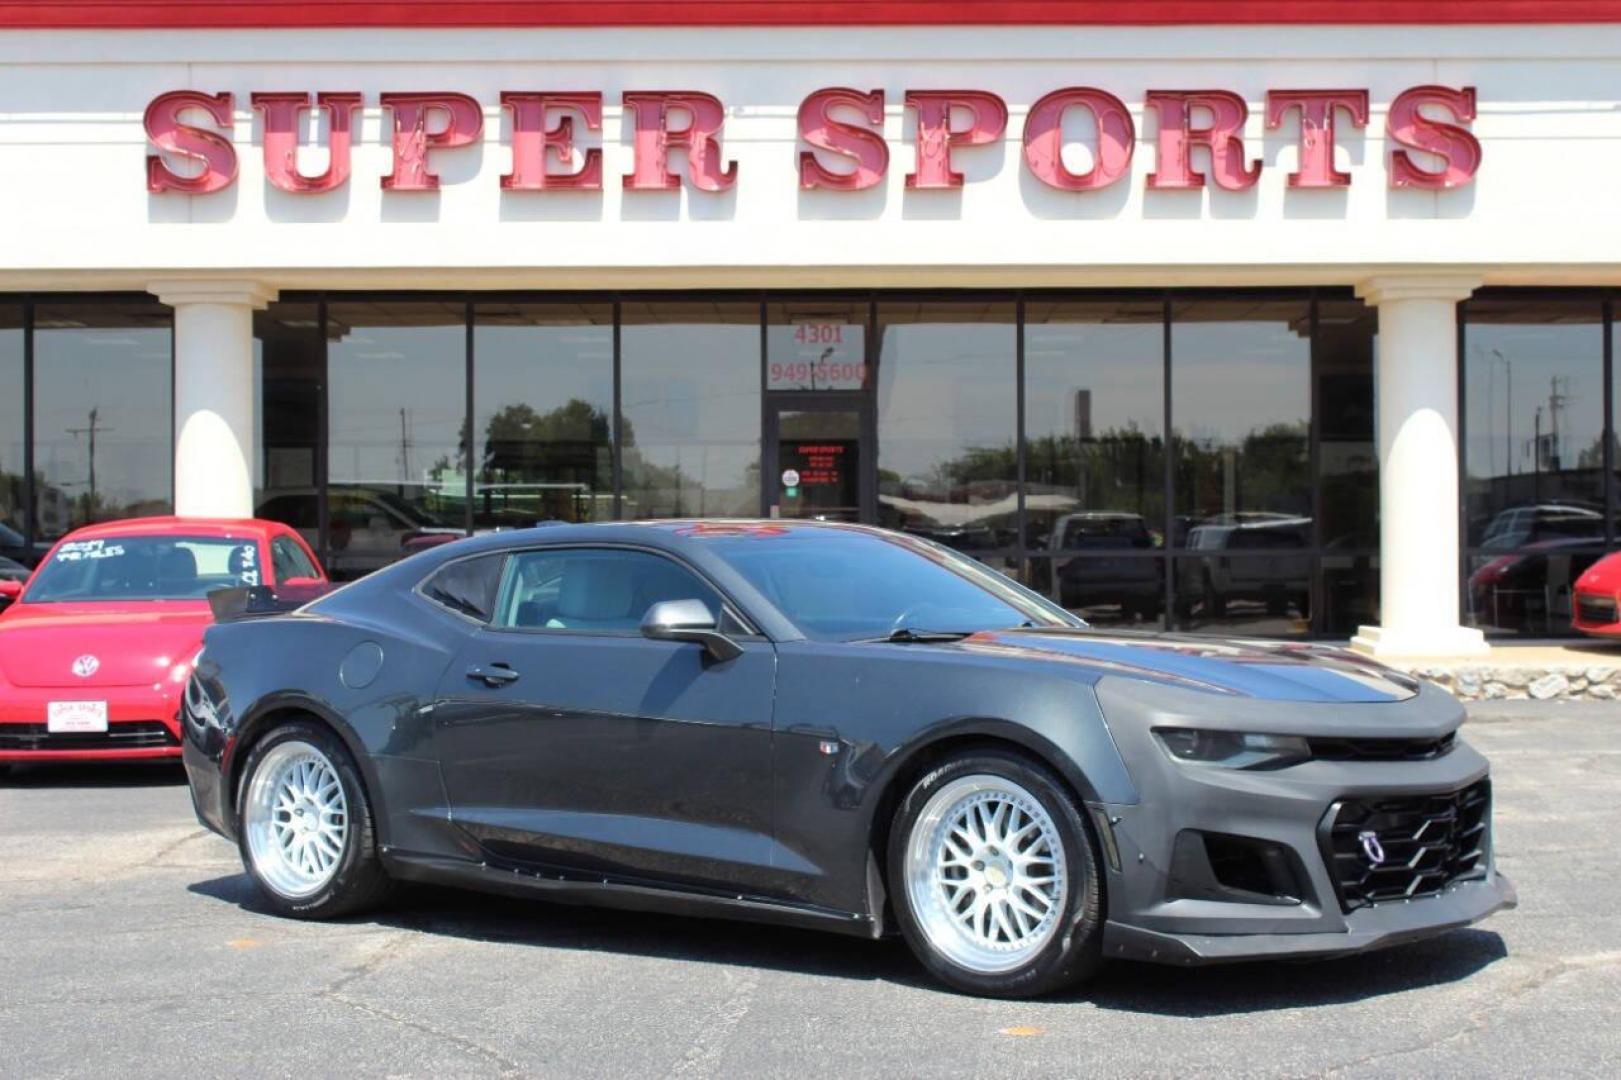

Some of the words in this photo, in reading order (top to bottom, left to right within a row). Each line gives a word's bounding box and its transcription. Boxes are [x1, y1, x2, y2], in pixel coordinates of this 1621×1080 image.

[144, 90, 738, 195] SUPER
[797, 86, 1482, 192] SPORTS
[794, 323, 844, 344] 4301
